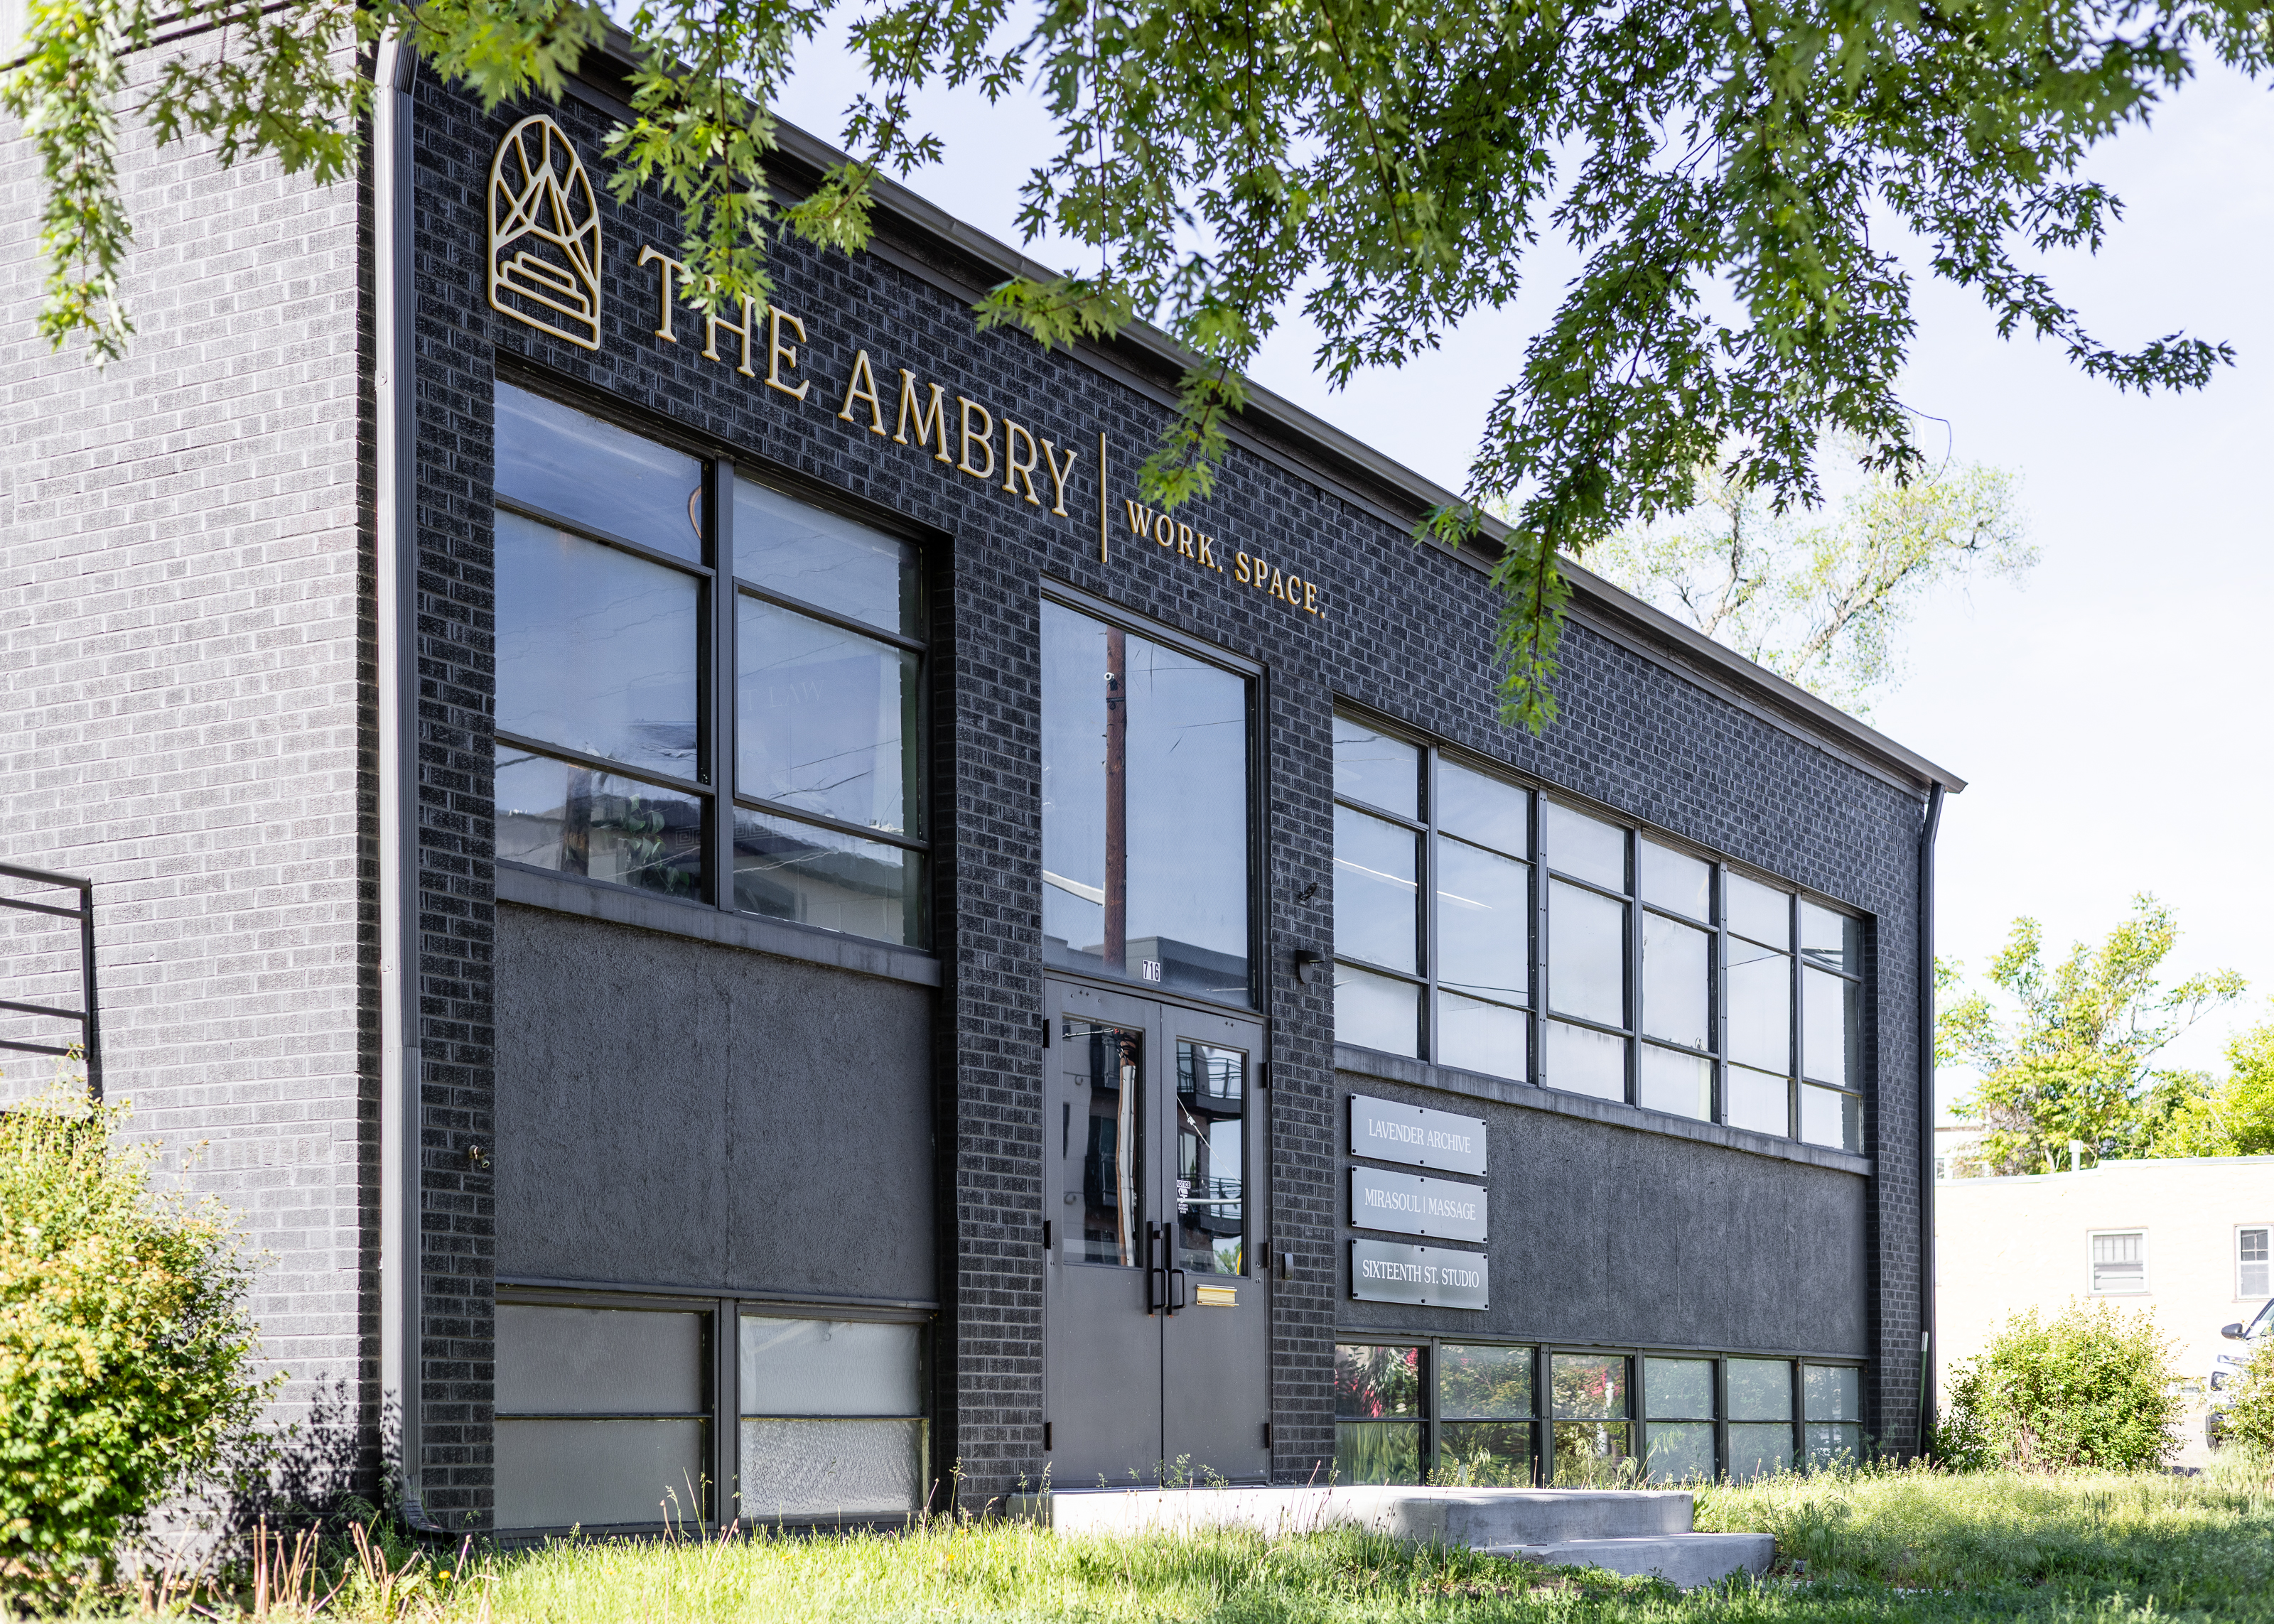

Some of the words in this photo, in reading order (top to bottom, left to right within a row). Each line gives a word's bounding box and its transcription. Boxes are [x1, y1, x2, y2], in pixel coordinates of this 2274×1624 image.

[637, 244, 810, 401] THE
[838, 350, 1078, 518] AMBRY
[1126, 499, 1223, 573] WORK.
[1234, 551, 1325, 619] SPACE.
[767, 679, 825, 709] LAW
[1143, 960, 1160, 981] 716
[1369, 1118, 1425, 1145] LAVENDER
[1427, 1130, 1472, 1154] ARCHIVE
[1364, 1188, 1421, 1213] MIRASOUL
[1428, 1198, 1477, 1220] MASSAGE
[1362, 1259, 1422, 1282] SIXTEENTH
[1424, 1266, 1439, 1284] ST.
[1441, 1268, 1480, 1288] STUDIO
